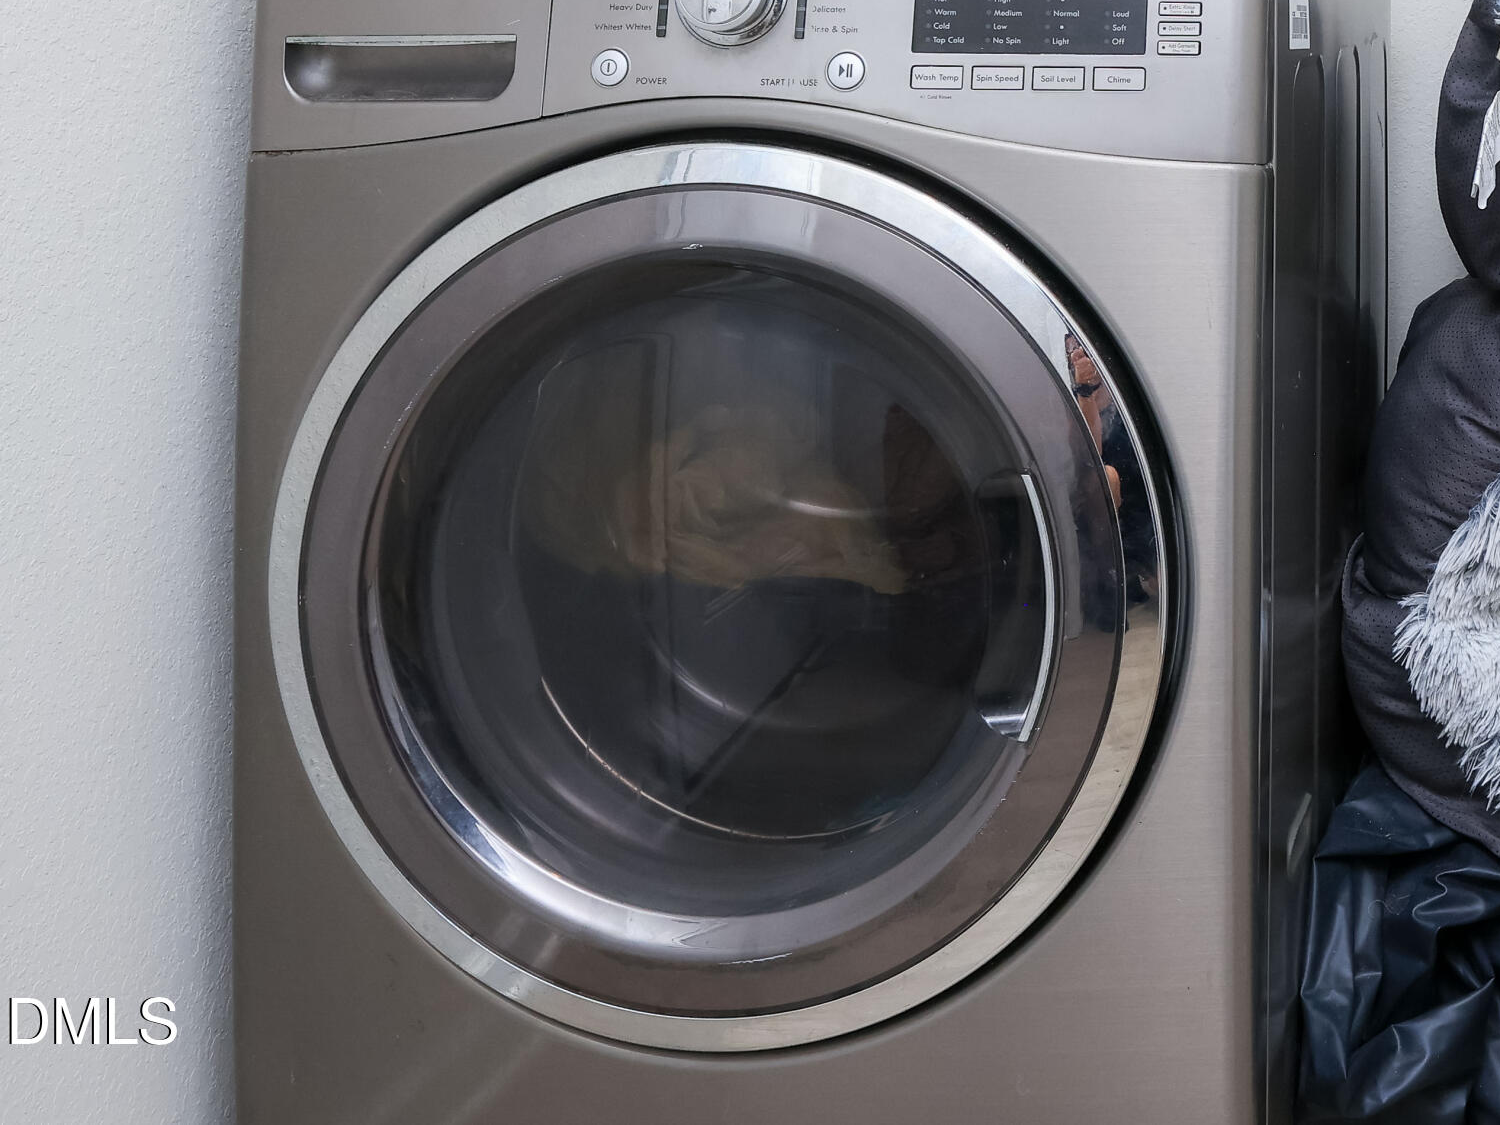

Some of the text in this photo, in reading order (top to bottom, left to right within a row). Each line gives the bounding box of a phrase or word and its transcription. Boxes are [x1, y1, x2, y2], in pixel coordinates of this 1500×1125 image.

[609, 4, 634, 12] Heavy
[1112, 10, 1130, 18] Loud
[594, 23, 652, 31] Whitest Whites
[811, 25, 830, 33] inse
[840, 26, 859, 35] Spin
[933, 22, 951, 30] Cold
[1112, 24, 1127, 32] Soft
[947, 36, 965, 44] Cold
[1005, 37, 1022, 45] Spin
[1052, 38, 1070, 46] Light
[1111, 38, 1125, 46] Off
[914, 73, 960, 83] Wash Temp
[975, 74, 1020, 83] Spin Speed
[1040, 75, 1076, 83] Soil Level
[1107, 76, 1131, 84] Chime
[760, 78, 819, 87] START USE
